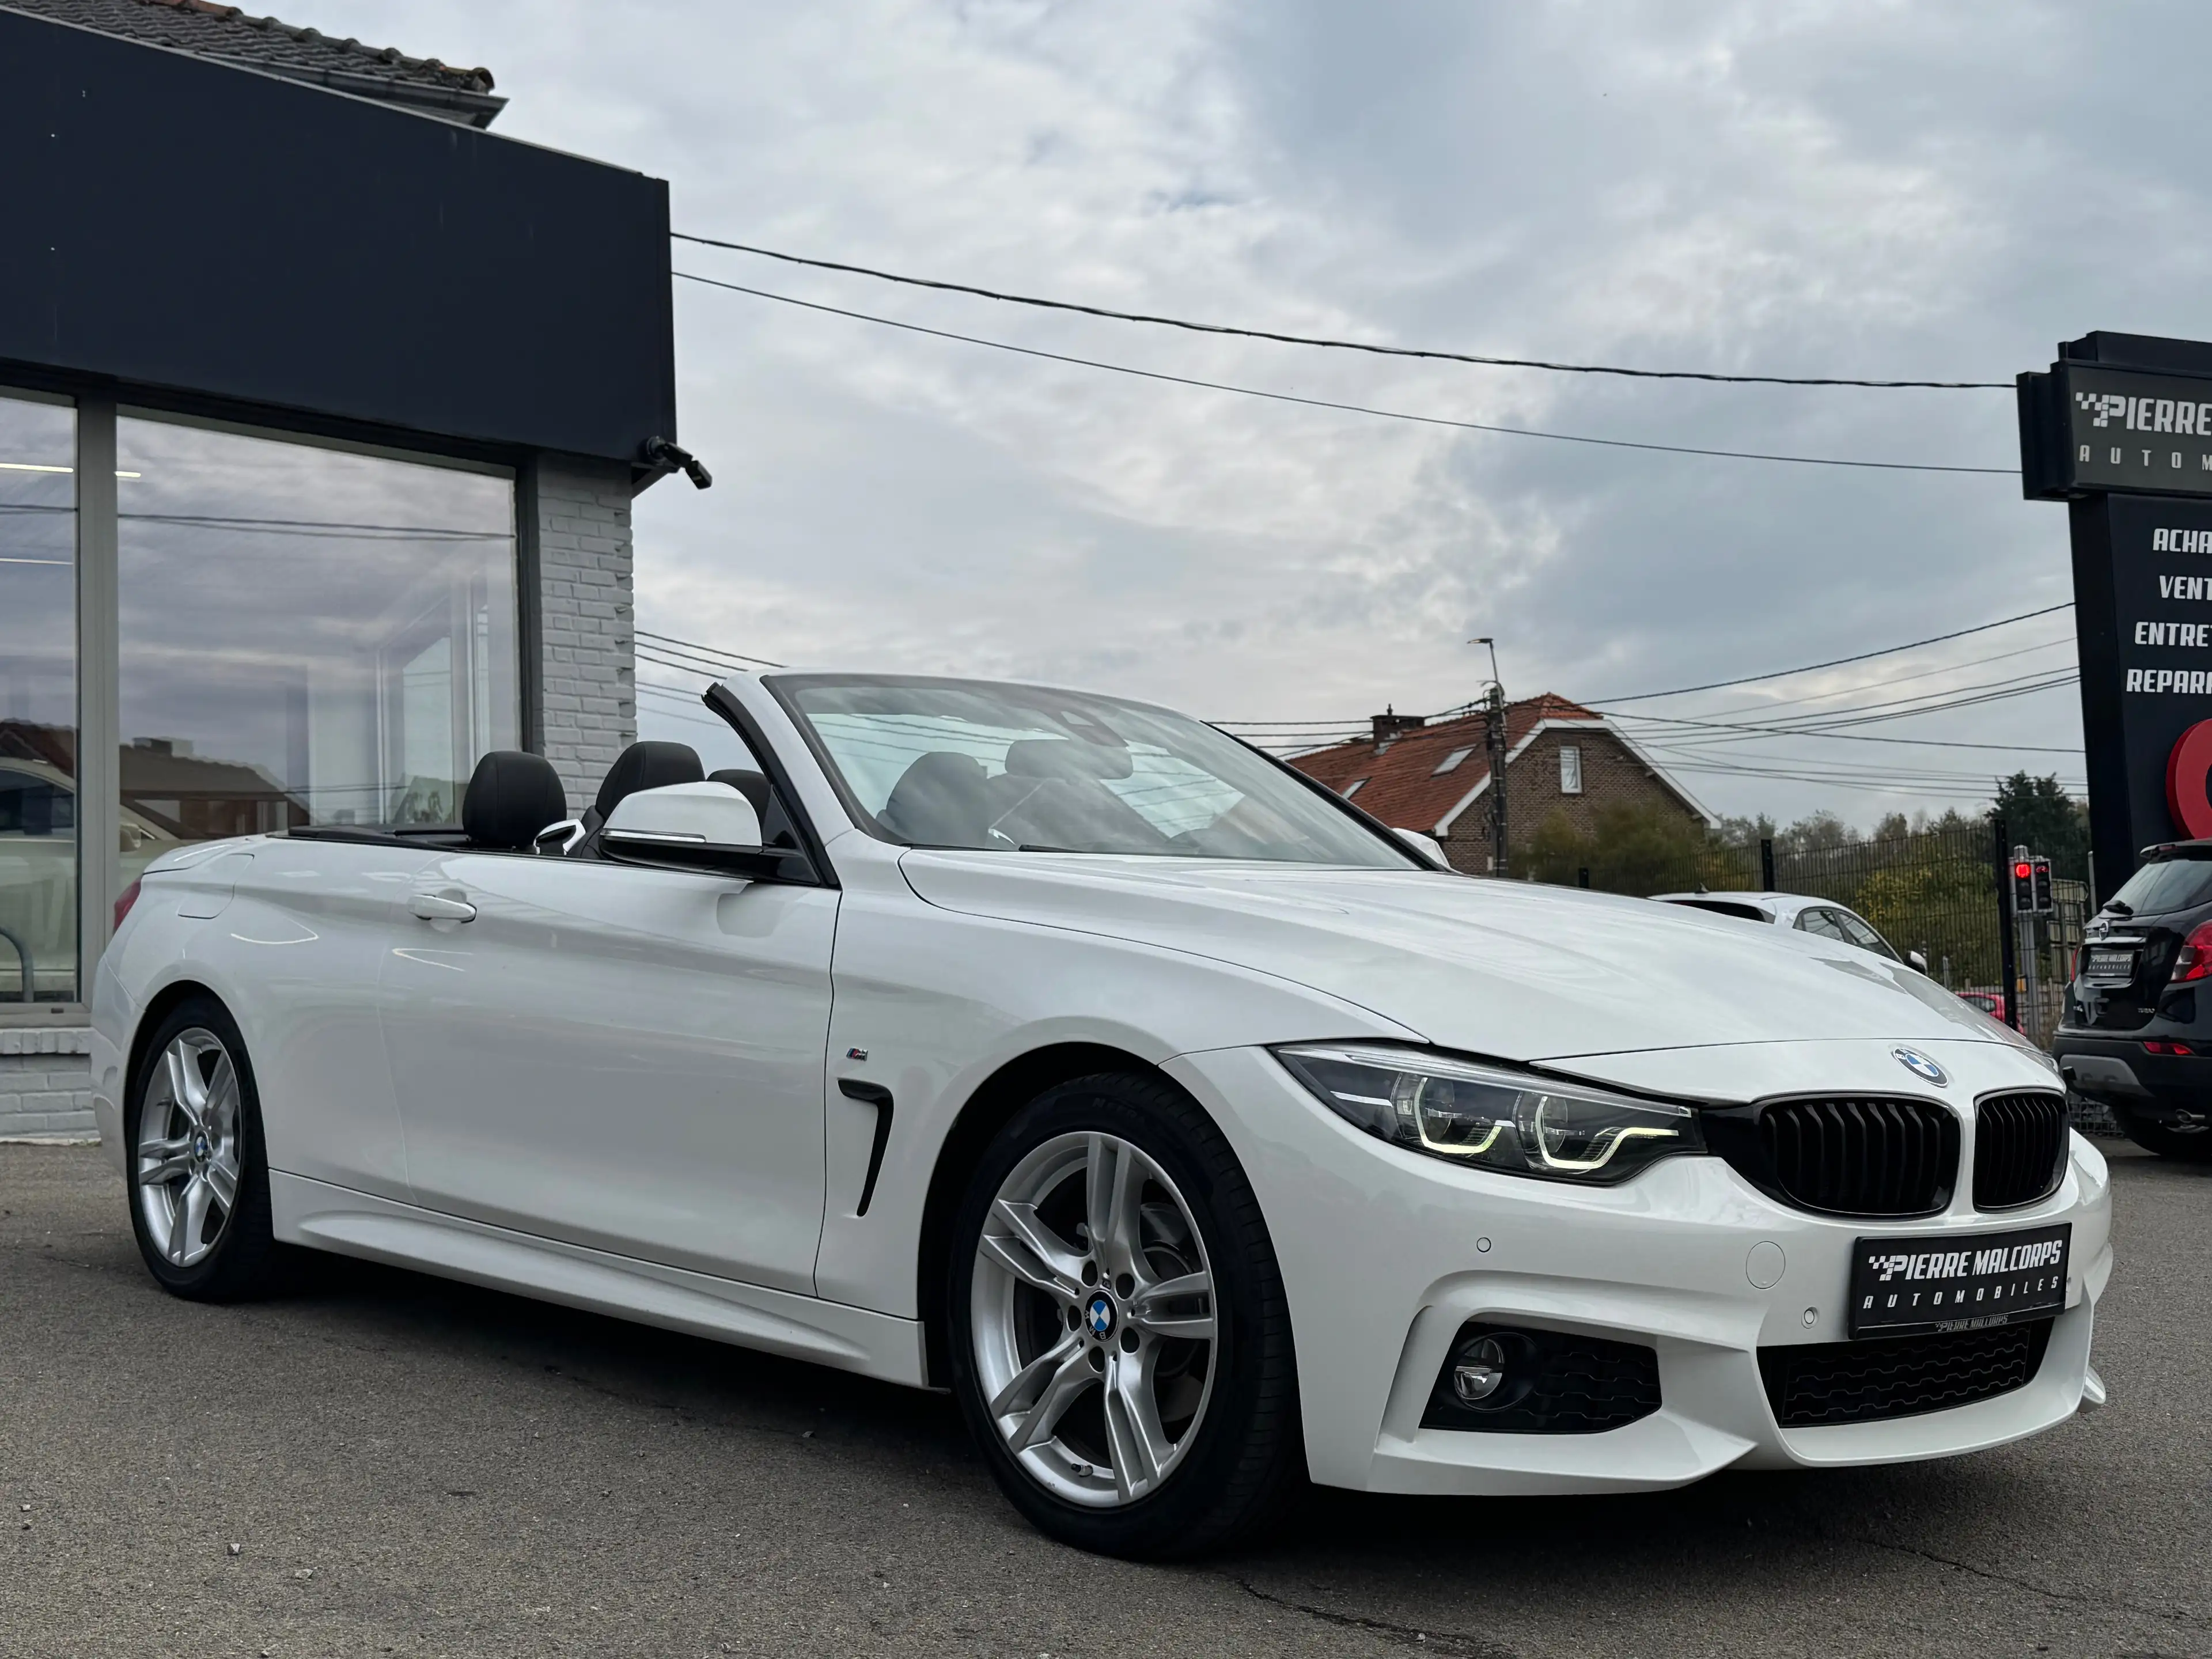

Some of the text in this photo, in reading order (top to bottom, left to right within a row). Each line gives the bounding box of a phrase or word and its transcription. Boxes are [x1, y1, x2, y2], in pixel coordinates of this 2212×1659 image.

[2093, 395, 2212, 436] PIERRE
[2153, 528, 2212, 554] ACHA
[2134, 621, 2212, 647] ENTRE
[1880, 1239, 2063, 1281] PIERRE MALCORPS
[1862, 1275, 2059, 1310] AUTOMOBILES
